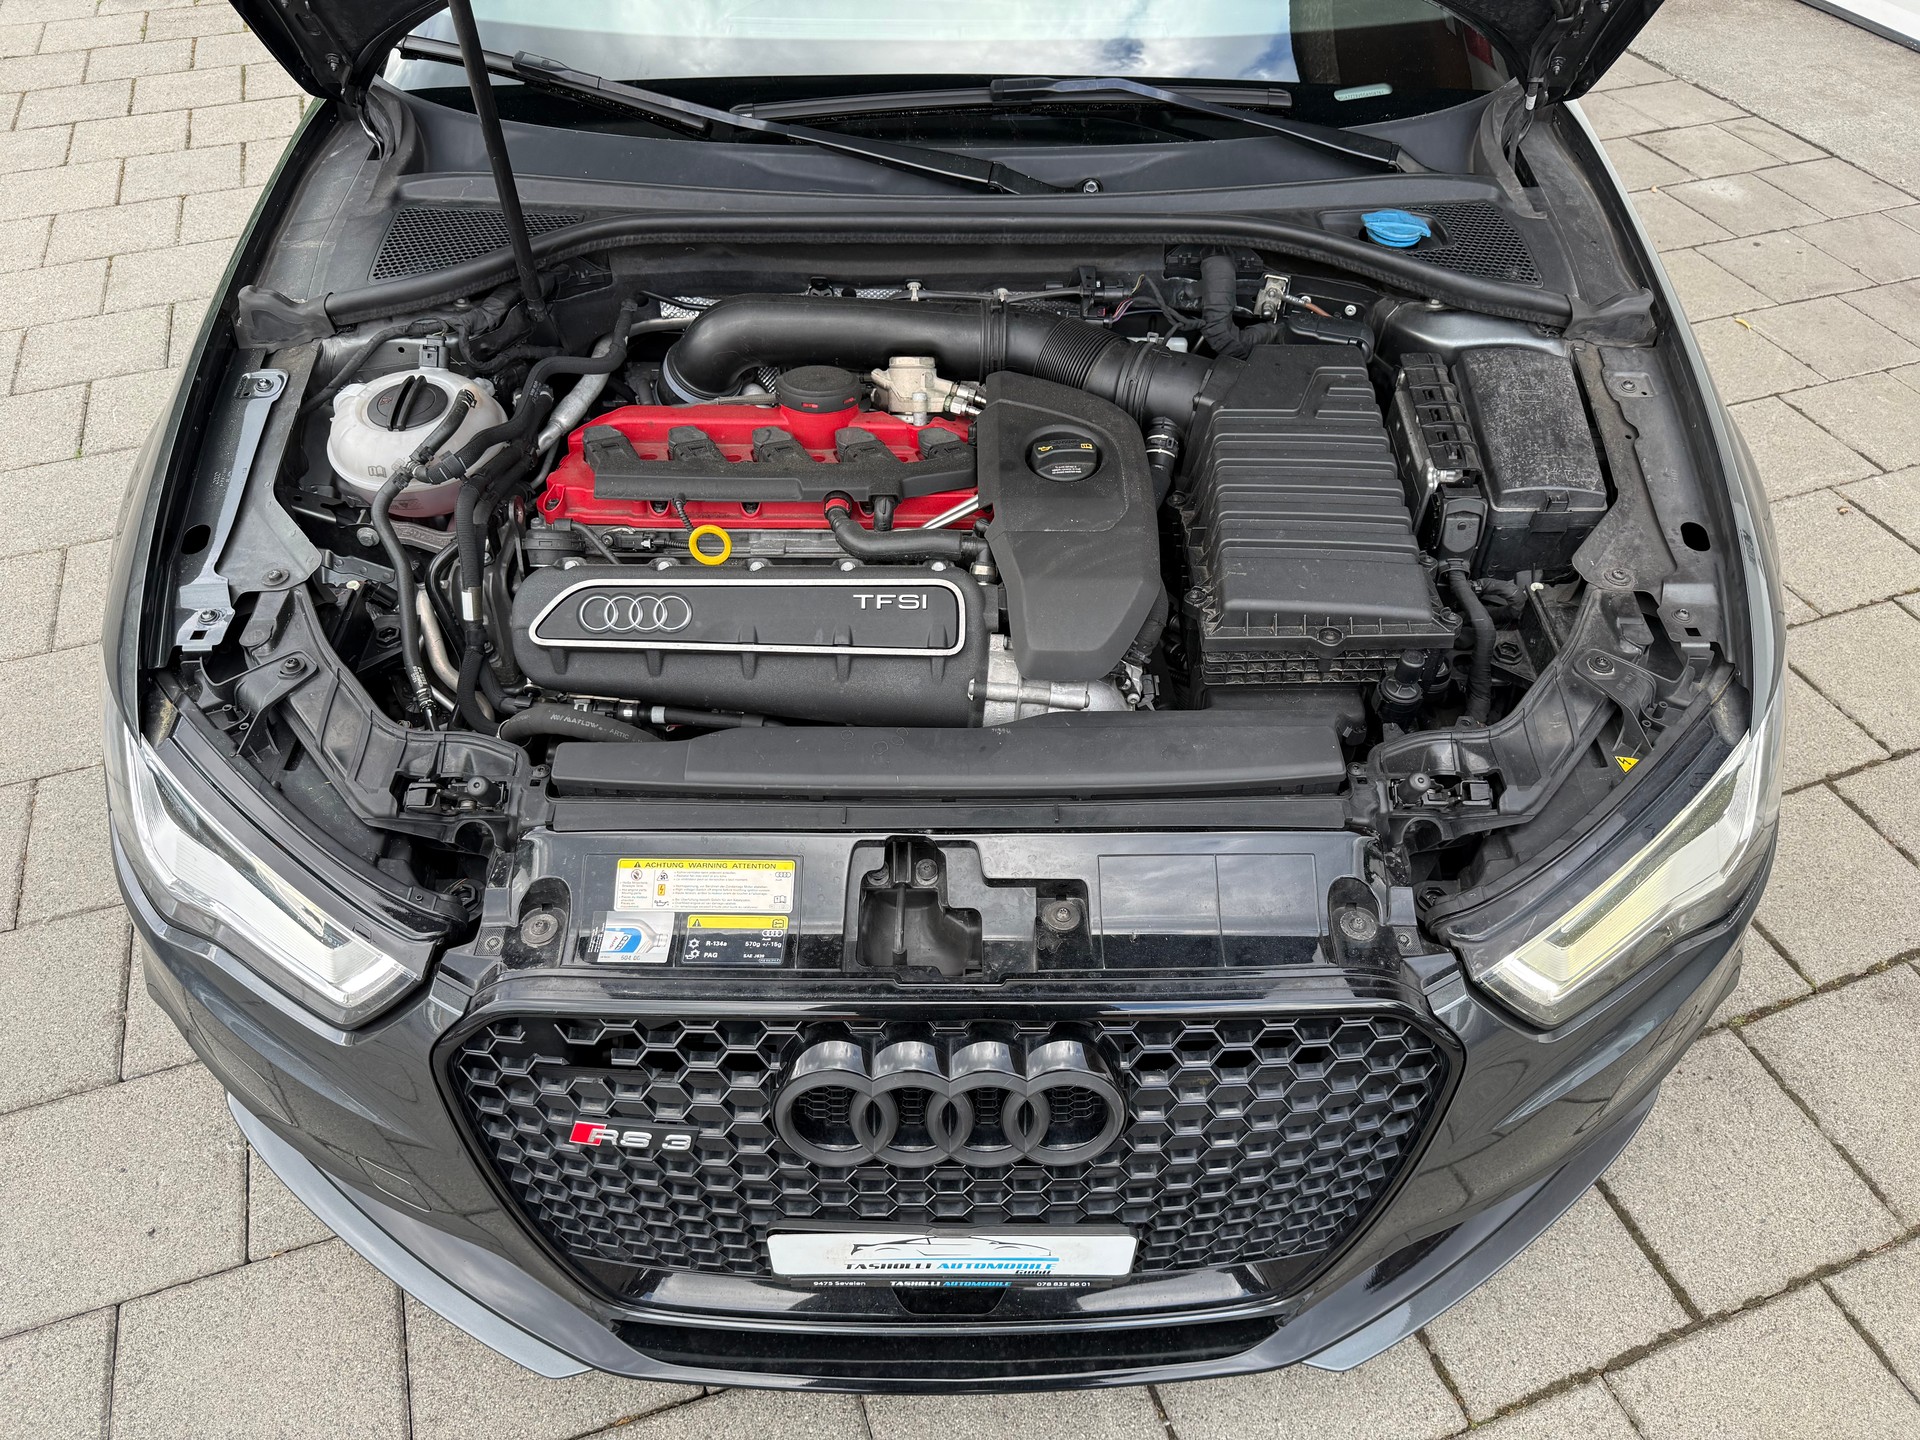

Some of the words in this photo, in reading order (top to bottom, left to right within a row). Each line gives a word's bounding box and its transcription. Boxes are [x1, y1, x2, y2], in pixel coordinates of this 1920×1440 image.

[852, 593, 928, 610] TFSI
[644, 861, 684, 869] ACHTUNG
[587, 1127, 653, 1148] RS
[661, 1134, 692, 1151] 3
[936, 1262, 1057, 1270] AUTOMOBILE
